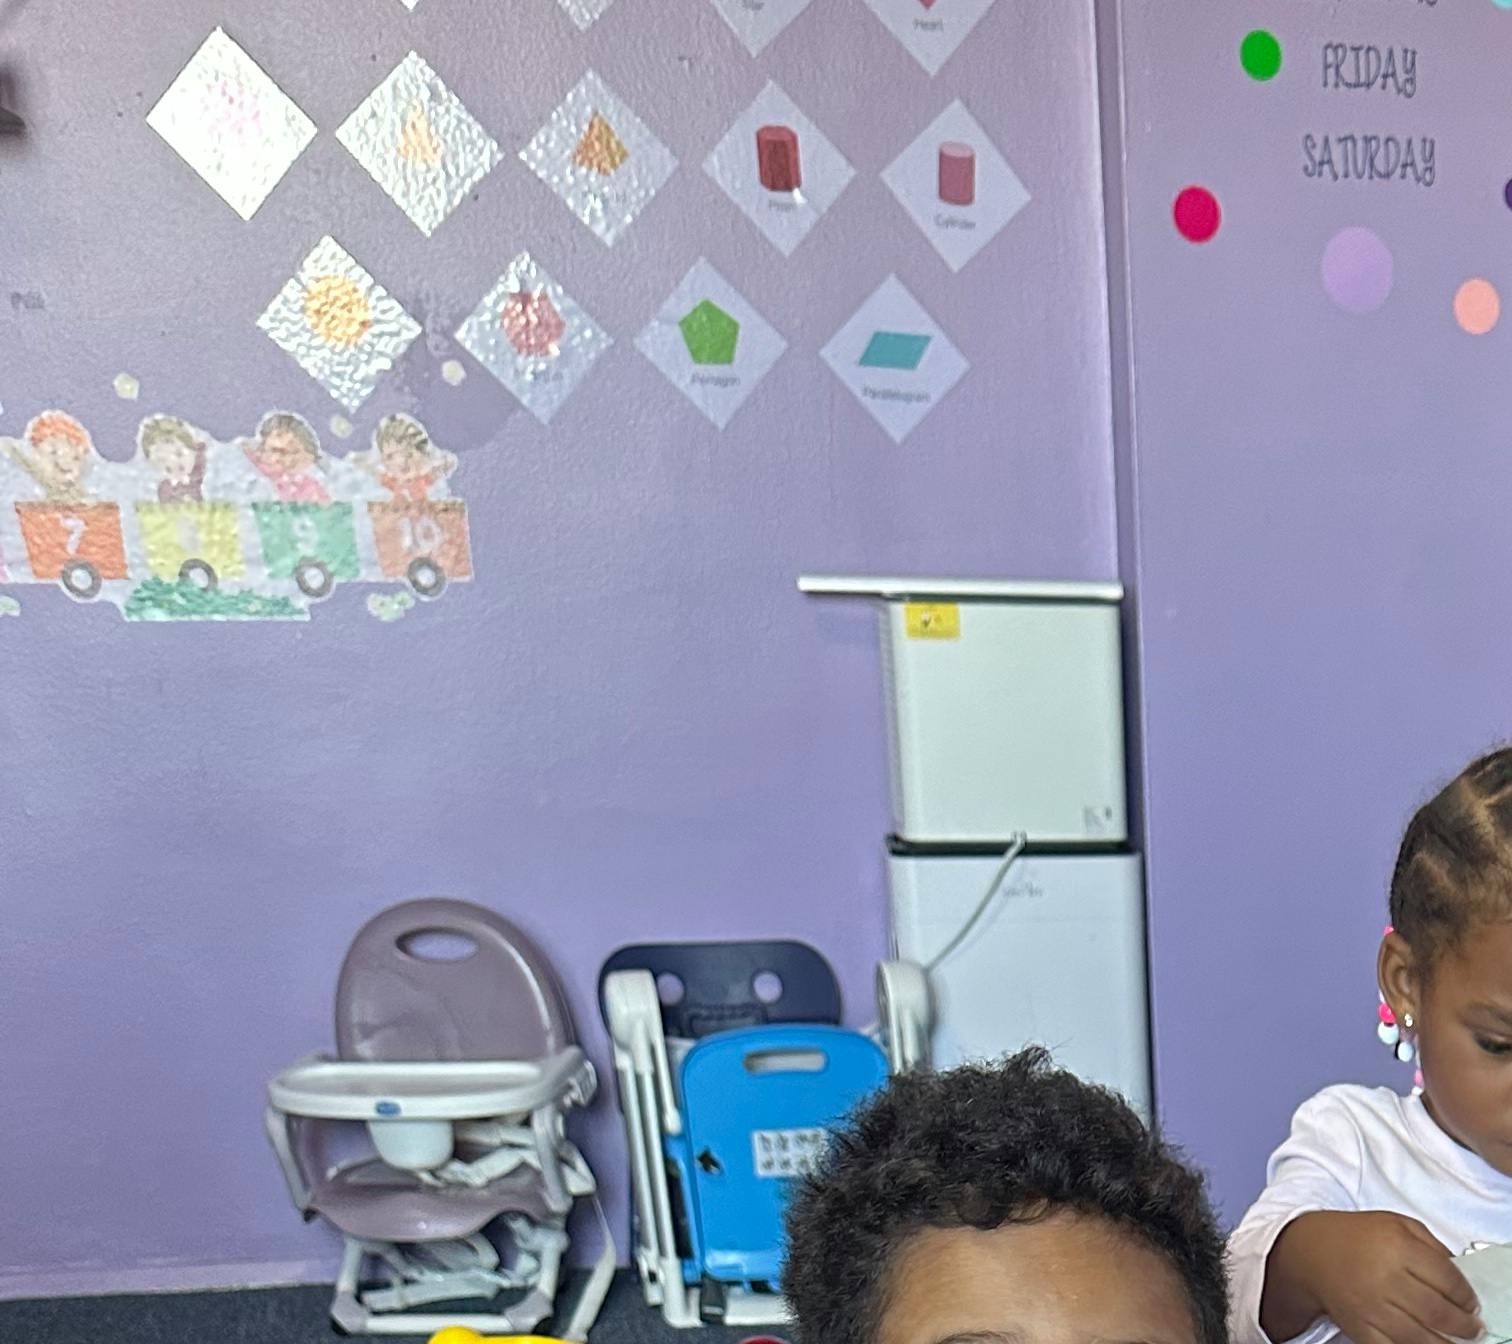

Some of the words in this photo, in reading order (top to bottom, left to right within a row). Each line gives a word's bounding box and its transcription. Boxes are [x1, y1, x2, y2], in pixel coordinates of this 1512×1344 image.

[1322, 41, 1417, 98] FRIDAY
[1303, 134, 1436, 187] SATURDAY
[60, 513, 86, 556] 7
